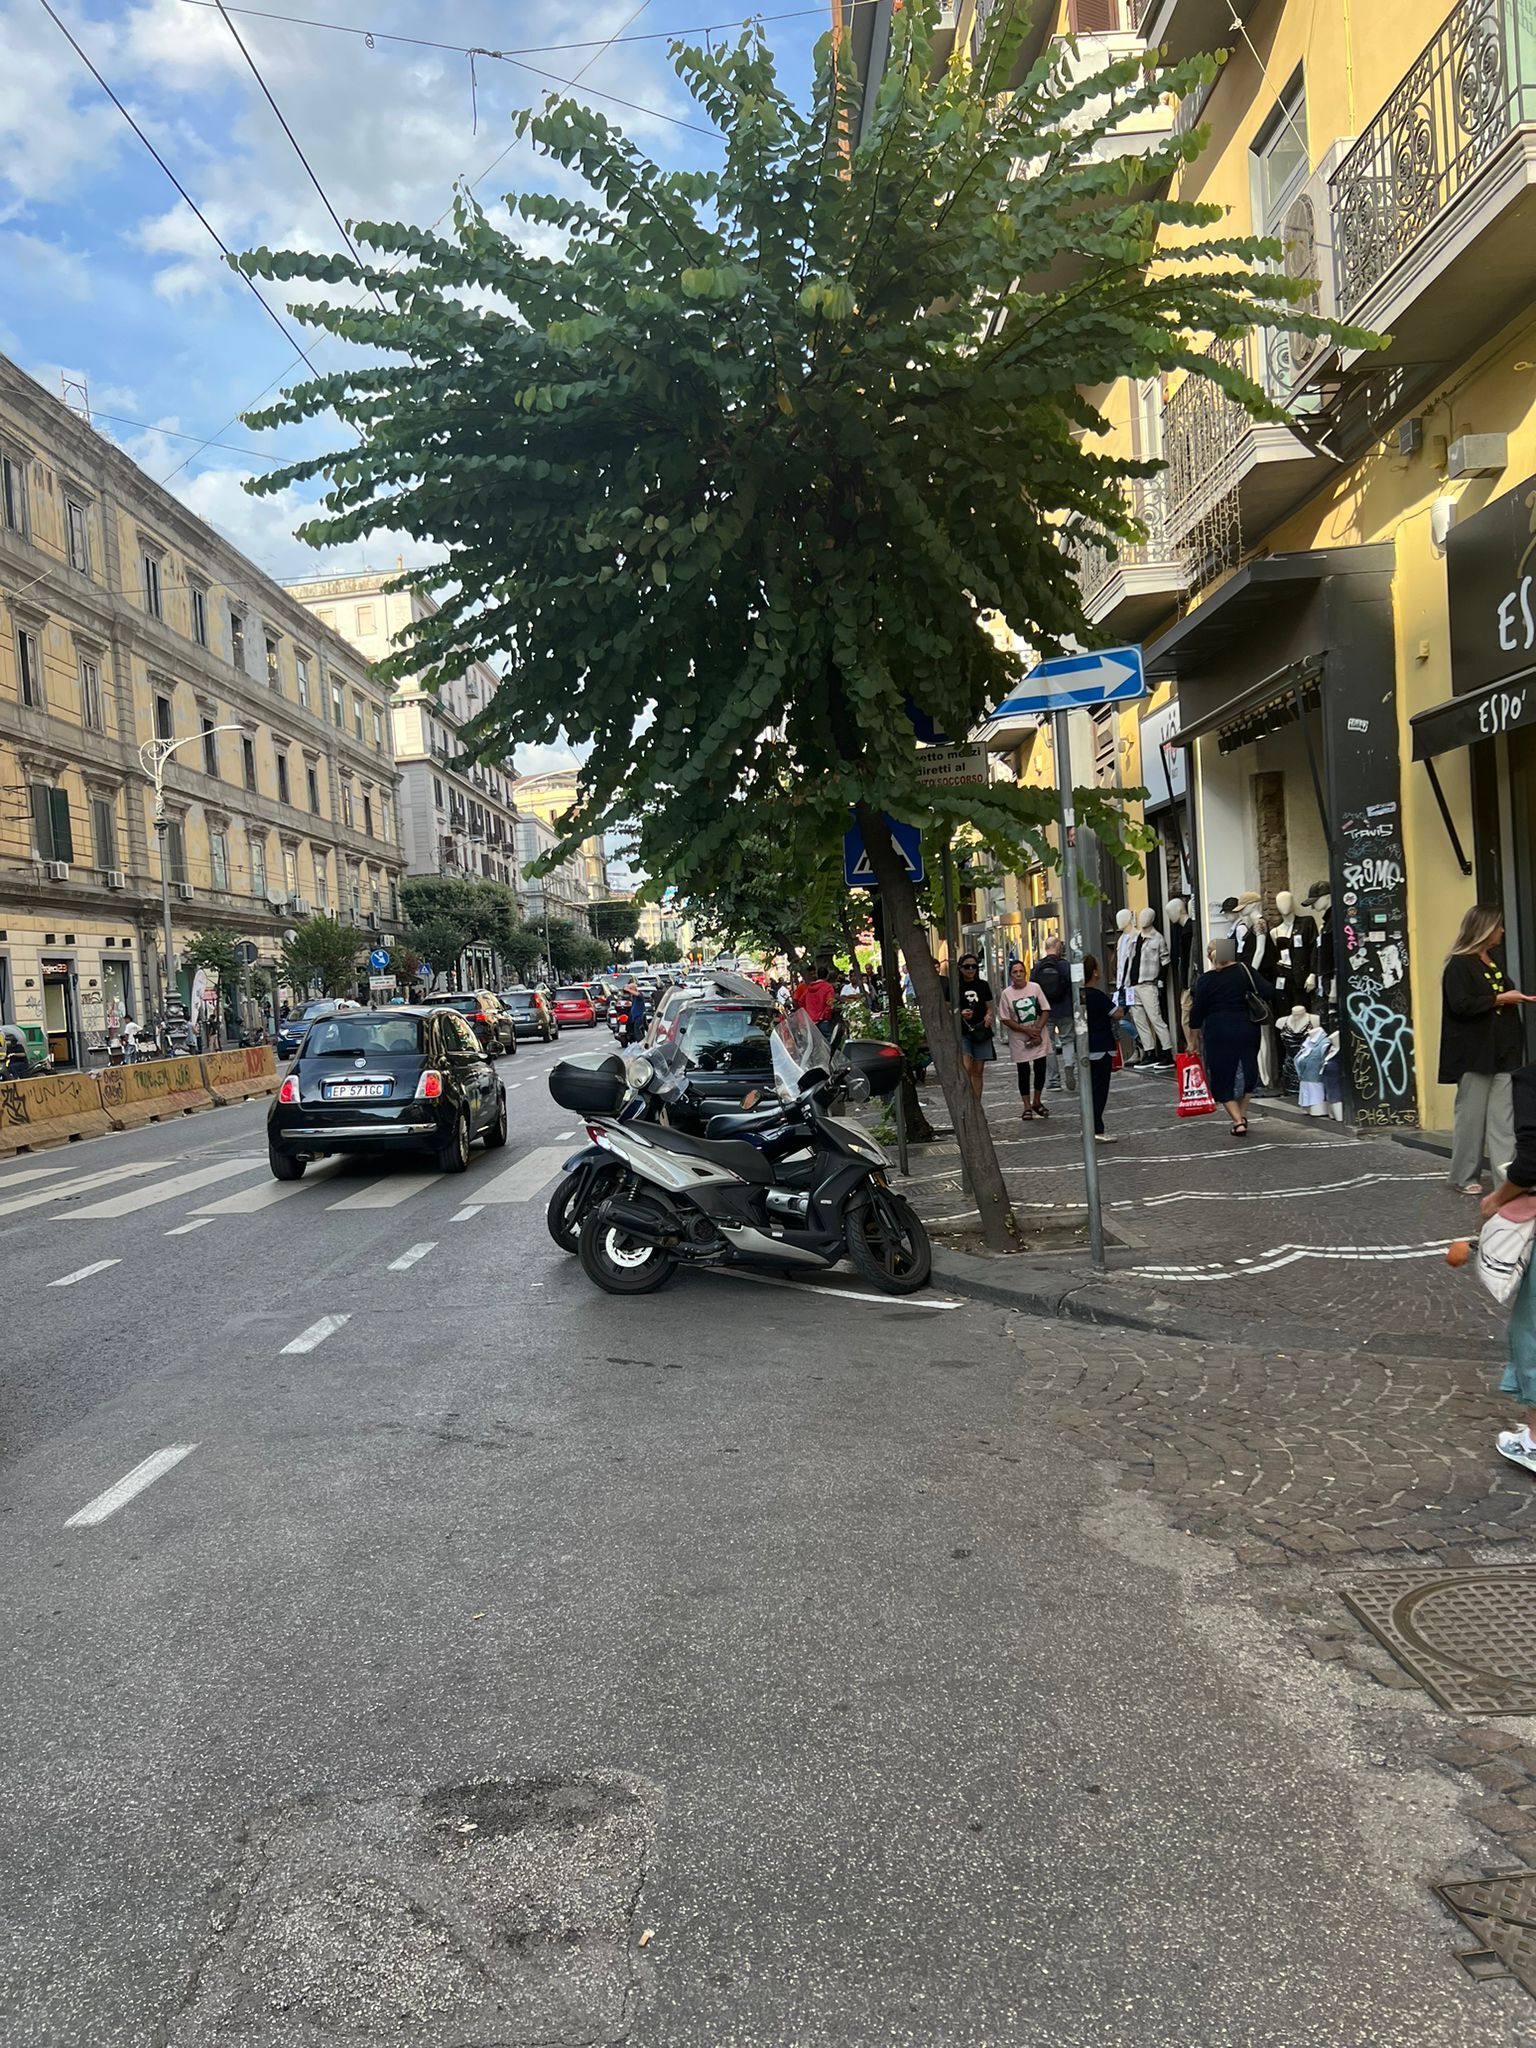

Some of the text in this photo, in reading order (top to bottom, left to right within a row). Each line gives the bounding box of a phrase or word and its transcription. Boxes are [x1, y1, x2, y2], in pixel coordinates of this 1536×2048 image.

[916, 748, 944, 762] etto
[955, 762, 966, 772] al
[937, 774, 984, 786] SOCCORSO
